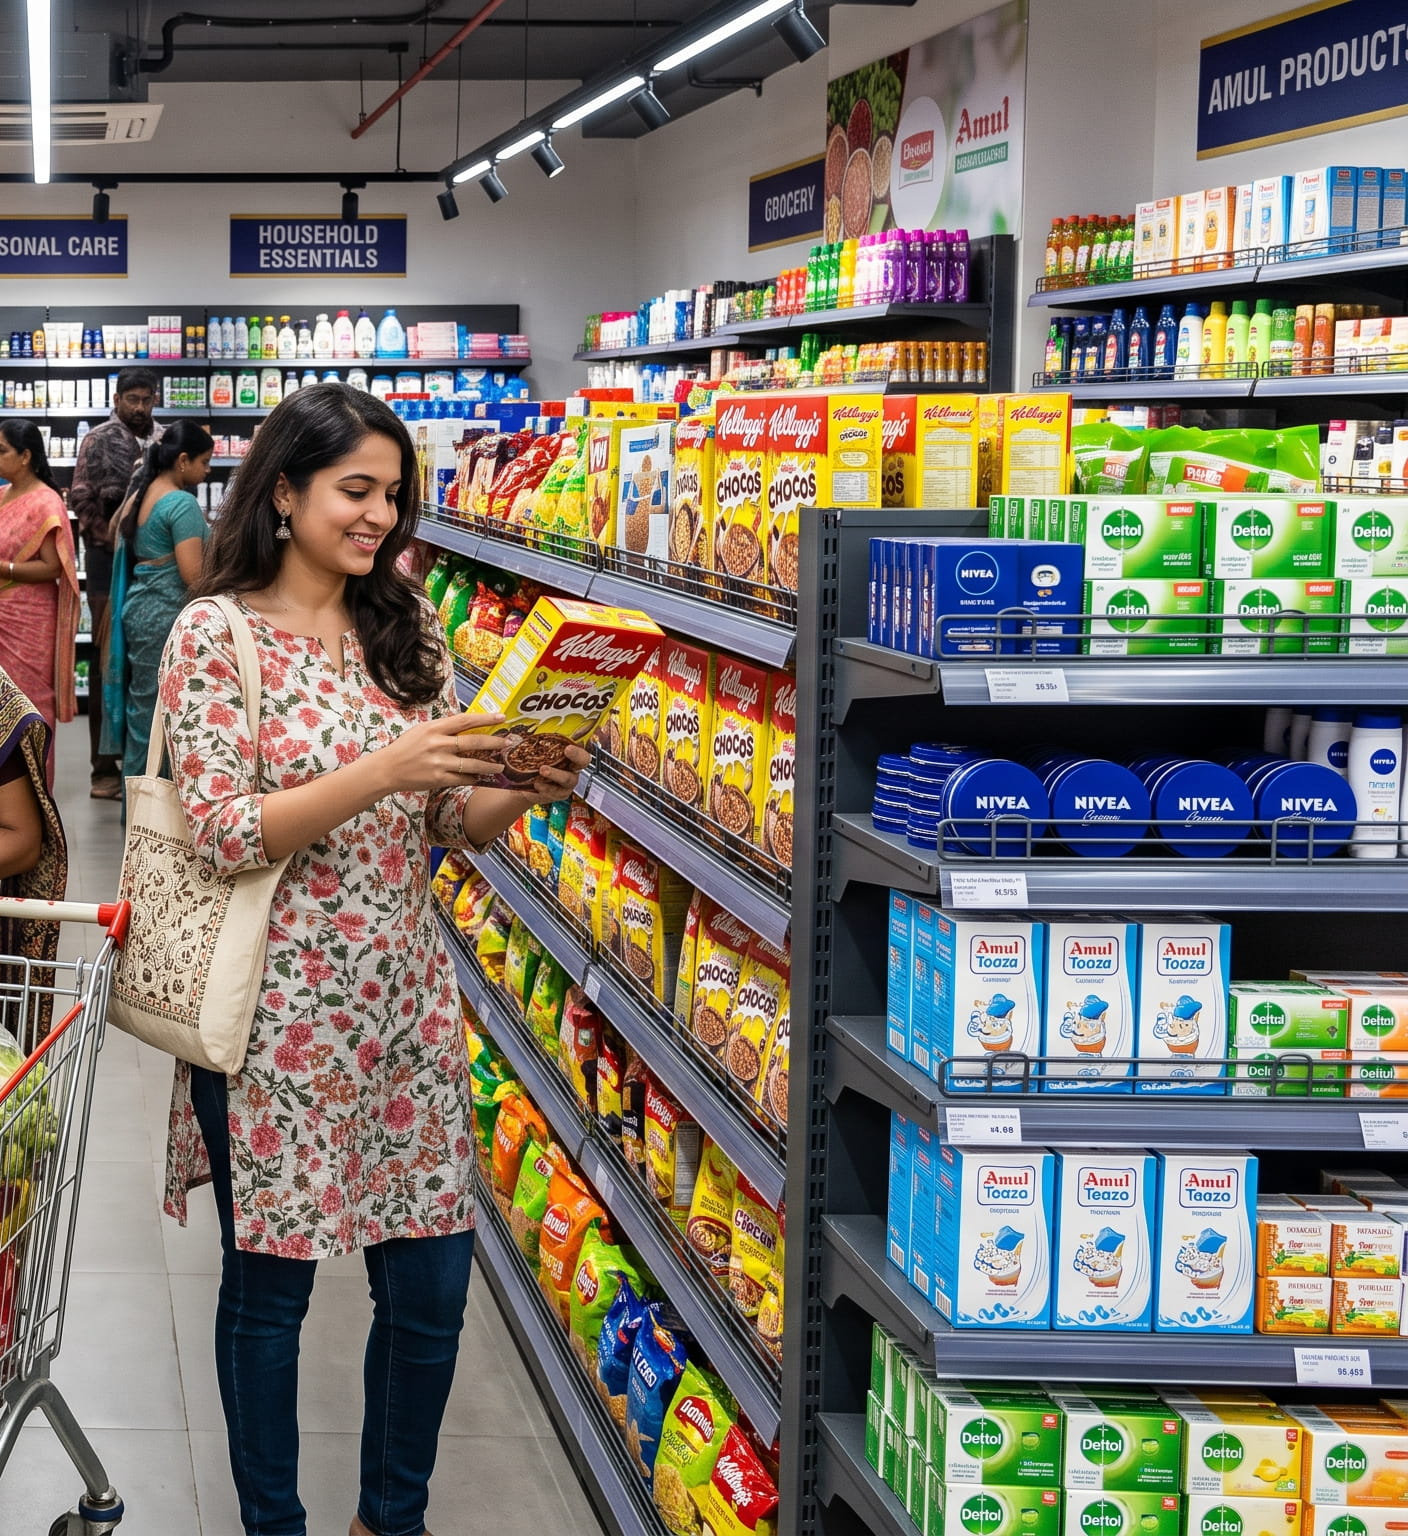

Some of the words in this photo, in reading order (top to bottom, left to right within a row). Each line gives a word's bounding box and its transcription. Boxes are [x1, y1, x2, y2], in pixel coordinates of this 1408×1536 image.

[1207, 64, 1272, 115] AMUL
[1279, 23, 1408, 96] PRODUCT
[955, 95, 1010, 148] Amul
[258, 225, 379, 245] HOUSEHOLD
[67, 236, 120, 256] CARE
[259, 249, 379, 269] ESSENTIALS
[717, 471, 762, 504] CHOCOS
[768, 472, 817, 507] CHOCOS
[1103, 523, 1142, 538] Dettol
[1232, 523, 1272, 538] Dettol
[552, 630, 646, 672] Kellogg's
[519, 691, 615, 713] CHOCOS
[666, 713, 700, 735] CHOCOS
[713, 733, 754, 758] CHOCOS
[976, 796, 1031, 810] NIVEA
[1074, 796, 1131, 810] NIVEA
[1178, 797, 1235, 811] NIVEA
[1280, 798, 1338, 812] NIVEA
[976, 940, 1020, 955] Amul
[1069, 942, 1113, 956] Amul
[1162, 942, 1206, 956] Amul
[983, 1171, 1029, 1186] Amul
[1083, 1172, 1129, 1187] Amul
[1184, 1173, 1232, 1188] Amul
[961, 1433, 1002, 1445] Dettol
[1082, 1439, 1122, 1452] Dettol
[1203, 1446, 1242, 1460] Dettol
[1326, 1456, 1366, 1470] Dettol
[1082, 1514, 1122, 1528] Dettol
[1202, 1519, 1242, 1533] Dettol
